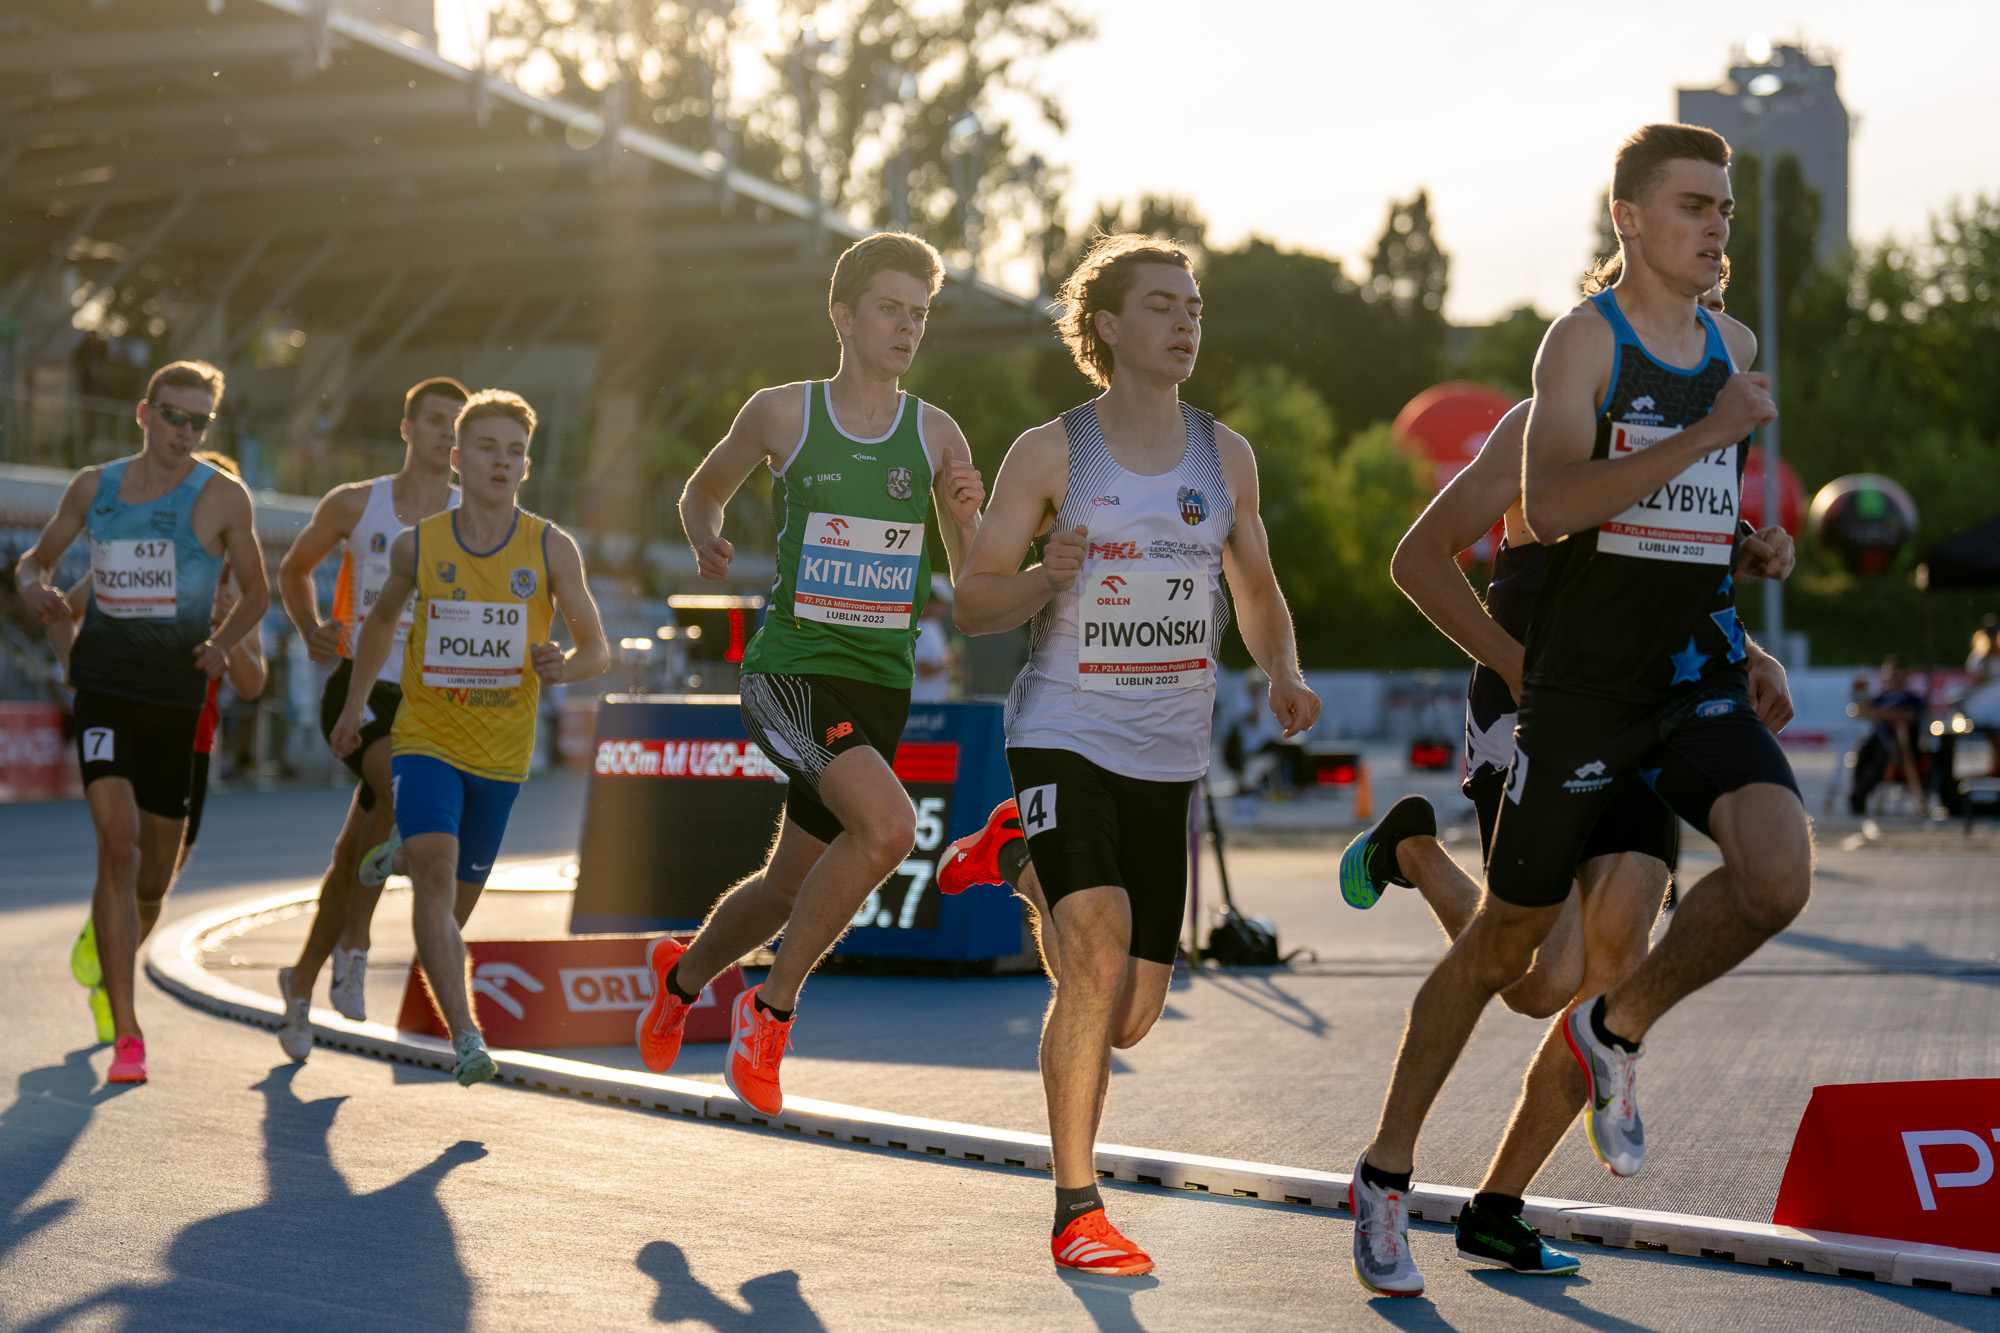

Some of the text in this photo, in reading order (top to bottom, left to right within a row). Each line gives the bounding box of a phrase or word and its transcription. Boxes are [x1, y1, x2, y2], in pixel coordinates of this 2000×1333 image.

[1629, 434, 1662, 446] lubel
[817, 473, 842, 481] UMCS
[1637, 483, 1734, 517] ZYBYŁA
[820, 528, 911, 549] ORLEN 97
[1611, 524, 1623, 534] 77.
[1624, 526, 1645, 537] PZLA
[1647, 528, 1695, 541] Mistrzostwa
[1696, 533, 1713, 542] Polski
[134, 542, 168, 558] 617
[1087, 541, 1144, 560] MKL
[1179, 542, 1198, 550] KLUB
[1638, 541, 1705, 556] LUBLIN 2023
[804, 557, 913, 591] KITLIŃSKI
[1166, 578, 1194, 600] 79
[804, 596, 814, 604] 77.
[815, 597, 832, 606] PZLA
[833, 600, 876, 612] Mistrzostwa
[1097, 597, 1131, 606] ORLEN
[482, 608, 519, 625] 510
[826, 611, 885, 624] LUBLIN 2023
[1084, 616, 1206, 647] PIWOŃSKI
[439, 636, 511, 658] POLAK
[1089, 660, 1200, 672] 77. PZLA Mistrzostwa Polski U20
[447, 677, 476, 685] LUBLIN
[1115, 675, 1179, 686] LUBLIN 2023
[89, 731, 107, 756] 7
[595, 740, 661, 775] 800m
[661, 741, 690, 776] M
[1027, 789, 1047, 828] 4
[912, 797, 946, 851] 5
[571, 975, 650, 1005] ORL
[1901, 1128, 2000, 1211] P
